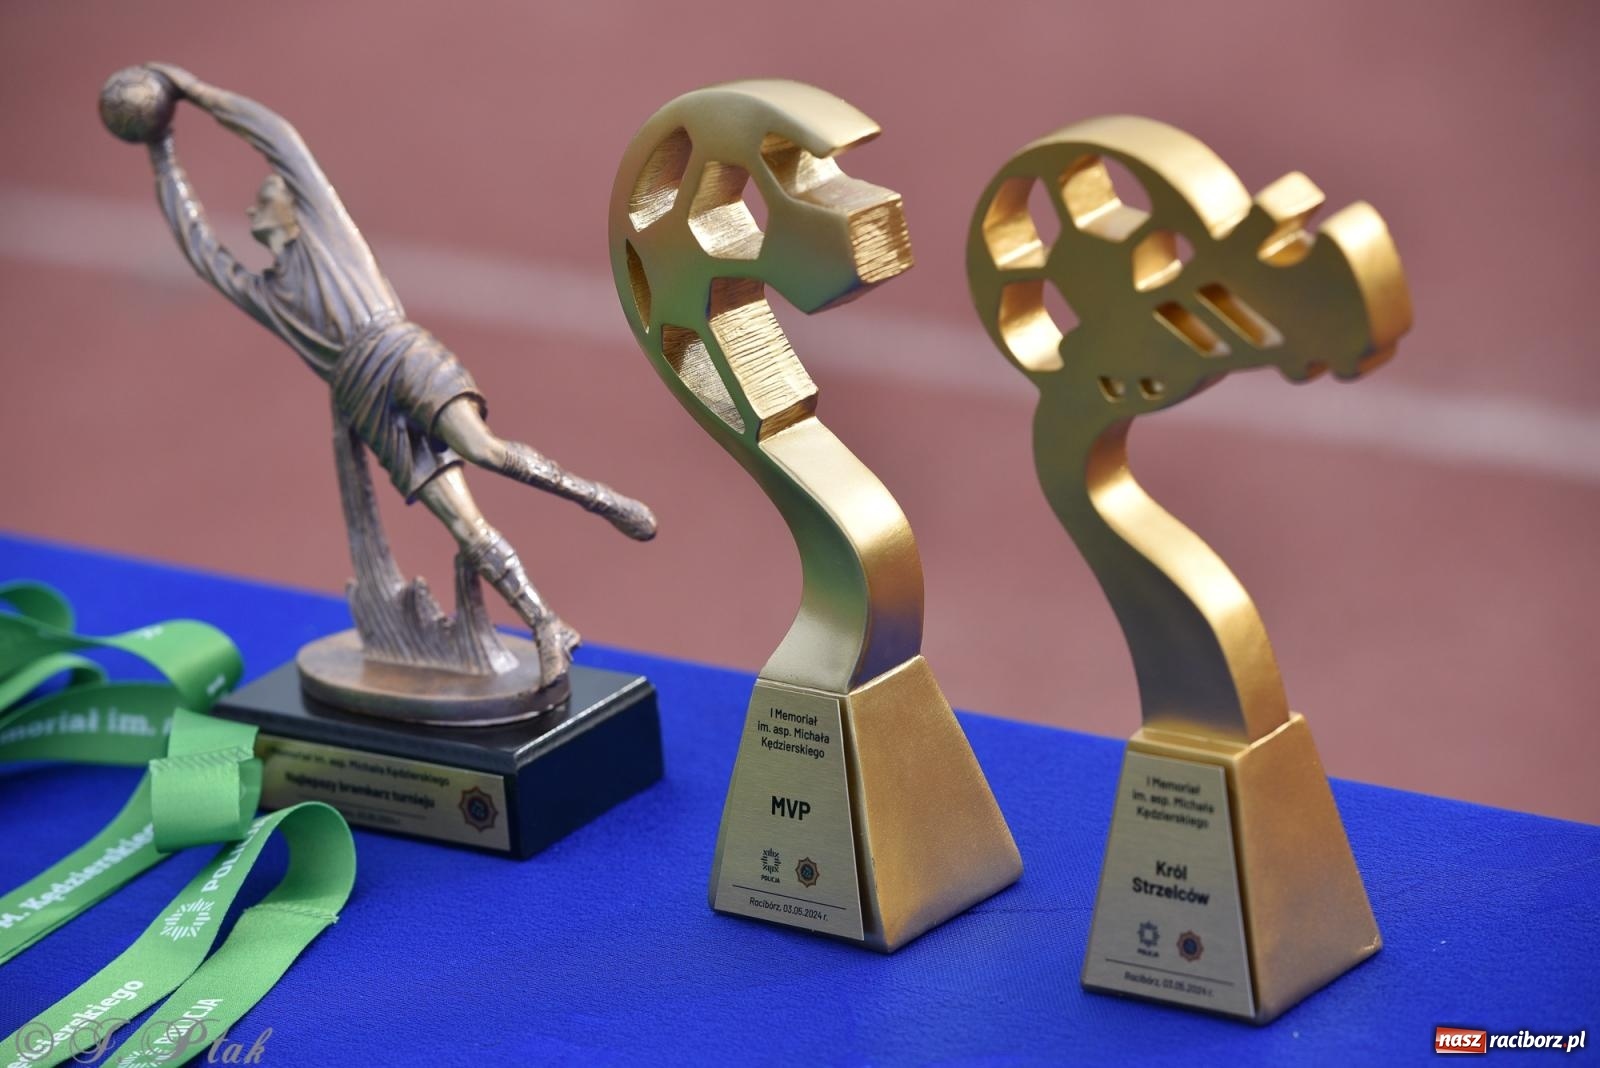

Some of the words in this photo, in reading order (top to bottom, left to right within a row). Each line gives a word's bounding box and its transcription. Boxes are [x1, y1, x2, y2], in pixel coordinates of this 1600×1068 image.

[775, 708, 818, 727] Memoriał
[757, 720, 772, 733] im.
[773, 725, 792, 739] asp.
[794, 727, 830, 744] Michała
[761, 736, 825, 759] Kędzierskiego
[771, 795, 811, 821] MVP
[760, 873, 781, 884] POLICJA
[1156, 860, 1188, 880] Król
[1132, 876, 1210, 905] Strzelców
[749, 896, 782, 913] Racibórz,
[783, 904, 822, 920] 03.05.2024
